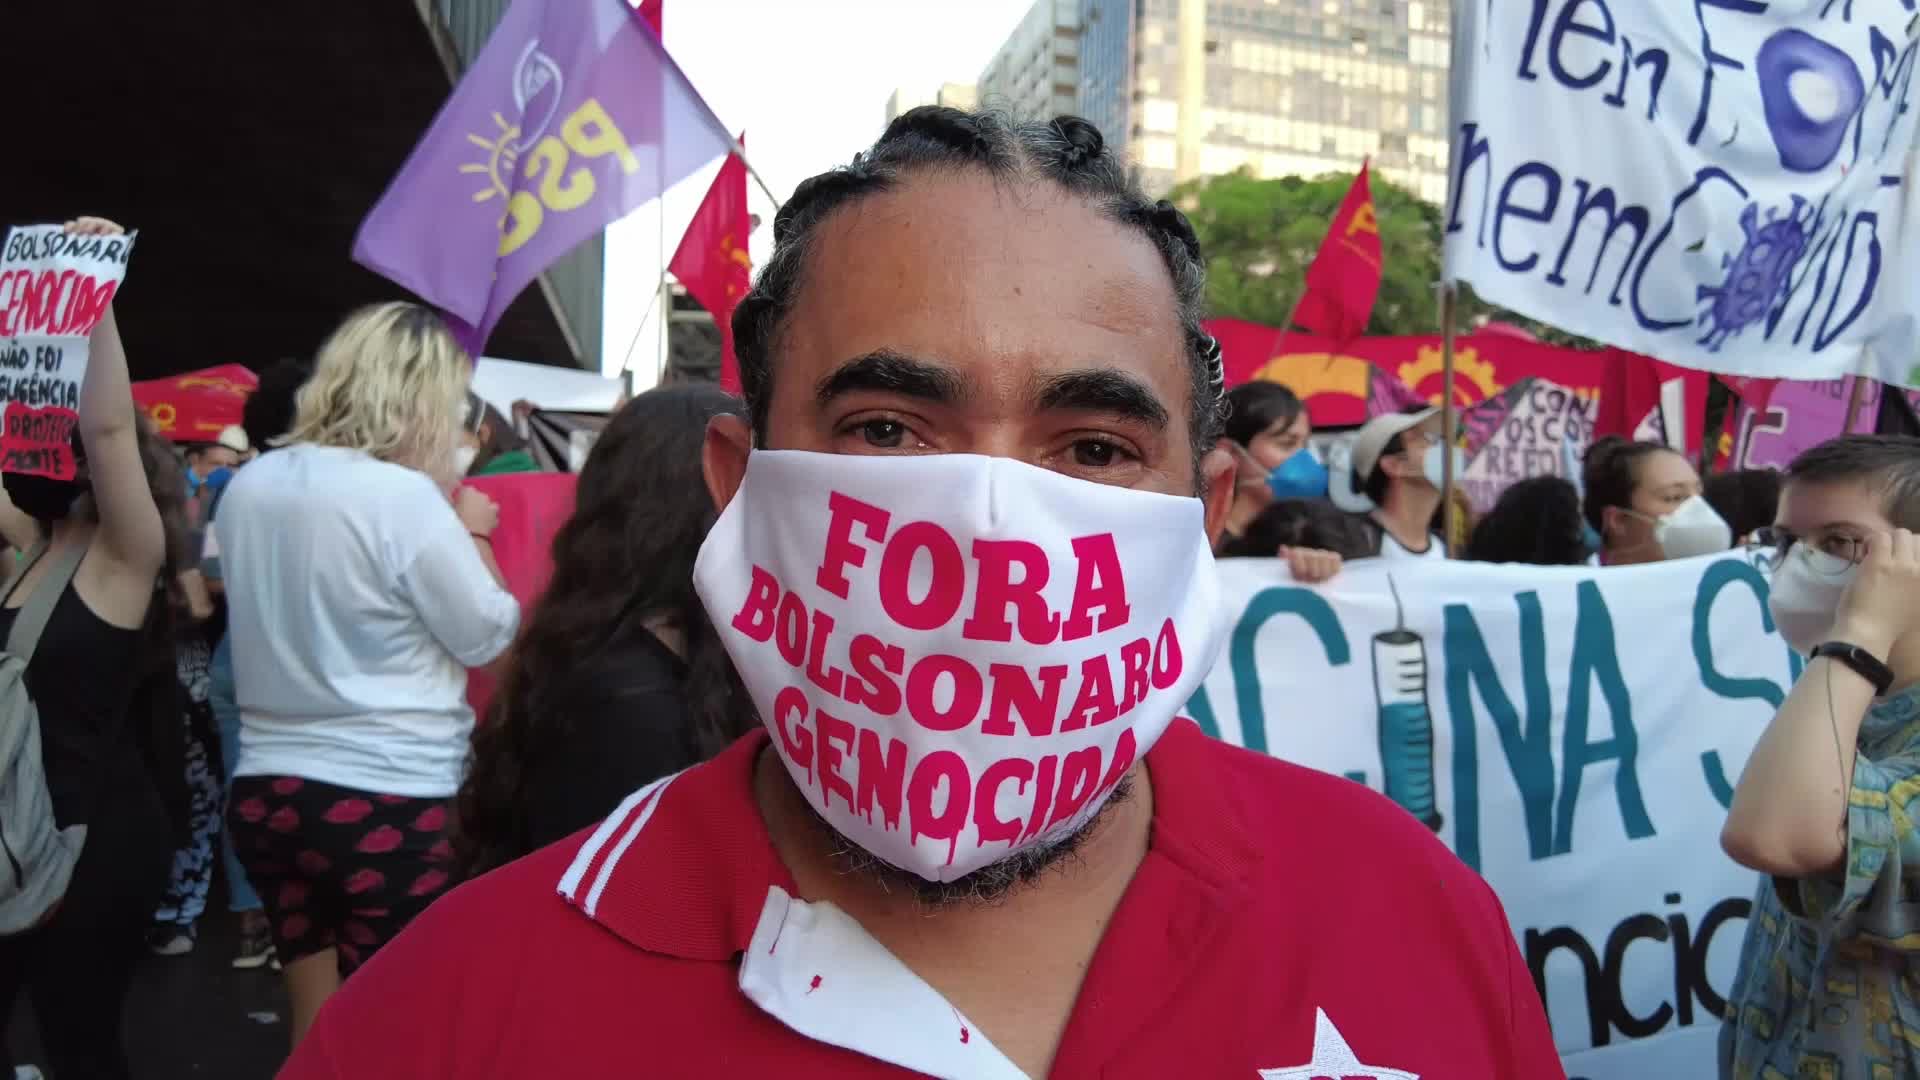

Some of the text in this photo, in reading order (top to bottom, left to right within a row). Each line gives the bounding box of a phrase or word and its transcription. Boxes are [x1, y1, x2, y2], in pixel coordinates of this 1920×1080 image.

[34, 345, 63, 373] FOI
[816, 490, 1131, 645] FORA
[731, 564, 1184, 737] BOLSONARO
[774, 686, 1138, 865] GENOCIDA
